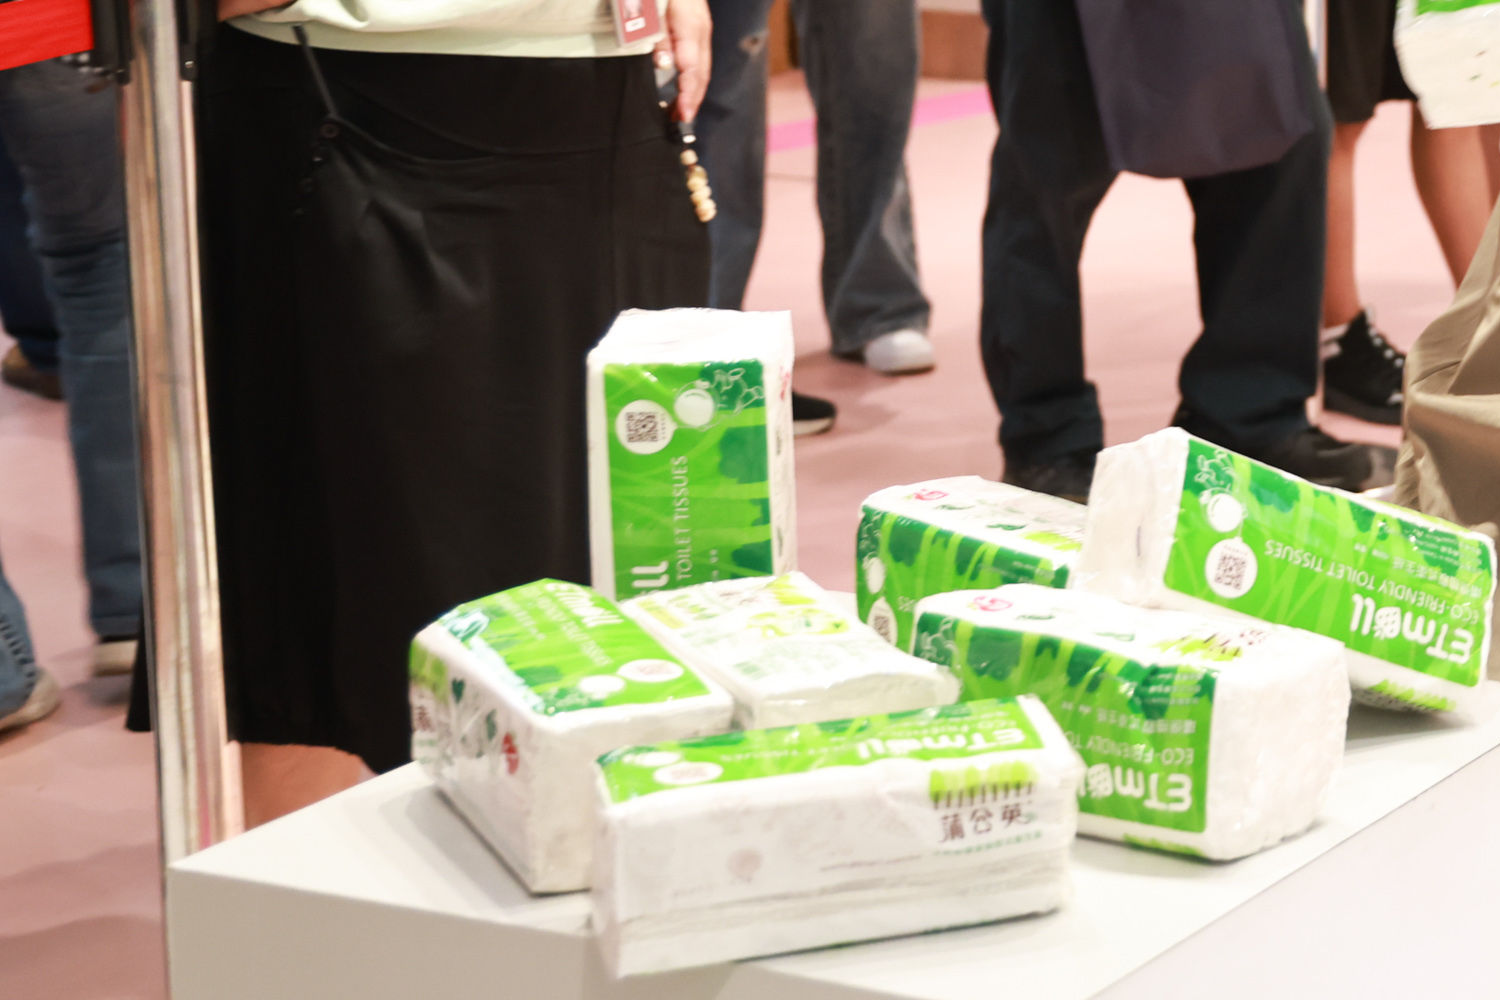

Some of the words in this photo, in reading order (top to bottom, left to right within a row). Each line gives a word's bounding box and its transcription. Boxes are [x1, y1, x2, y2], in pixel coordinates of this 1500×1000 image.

[670, 455, 690, 522] TISSUES
[675, 528, 693, 581] TOILET
[1264, 539, 1323, 573] TISSUES
[1326, 561, 1376, 590] TOILET
[1378, 580, 1480, 625] ECO-FRIENDLY
